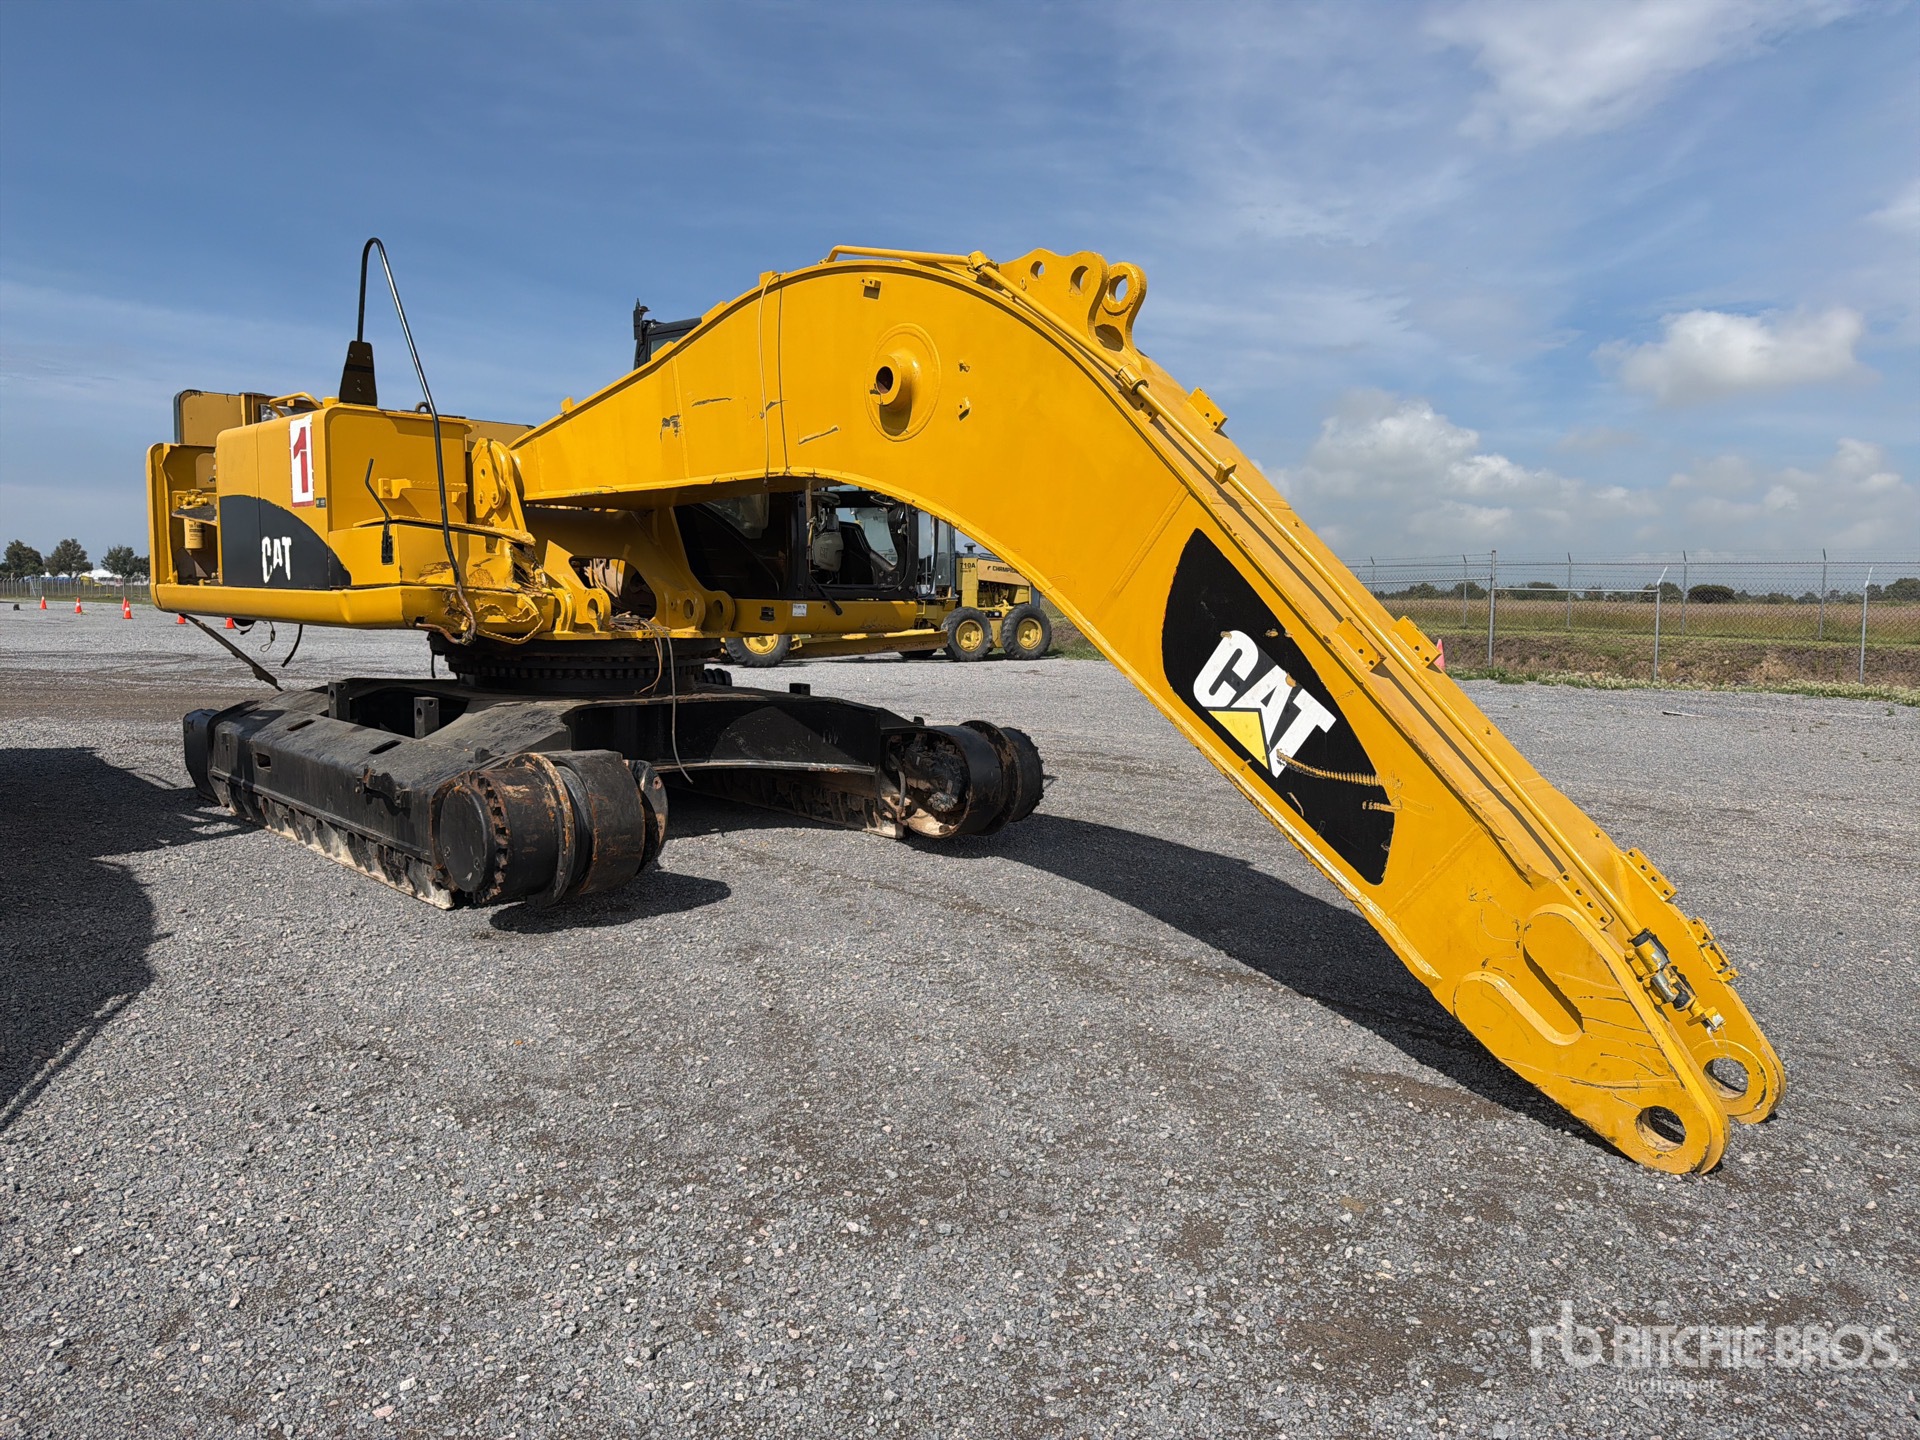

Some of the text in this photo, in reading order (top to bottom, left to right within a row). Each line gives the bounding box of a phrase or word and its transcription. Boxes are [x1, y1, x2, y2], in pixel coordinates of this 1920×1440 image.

[293, 427, 309, 493] 1
[261, 536, 292, 583] CAT
[1193, 630, 1337, 778] CAT
